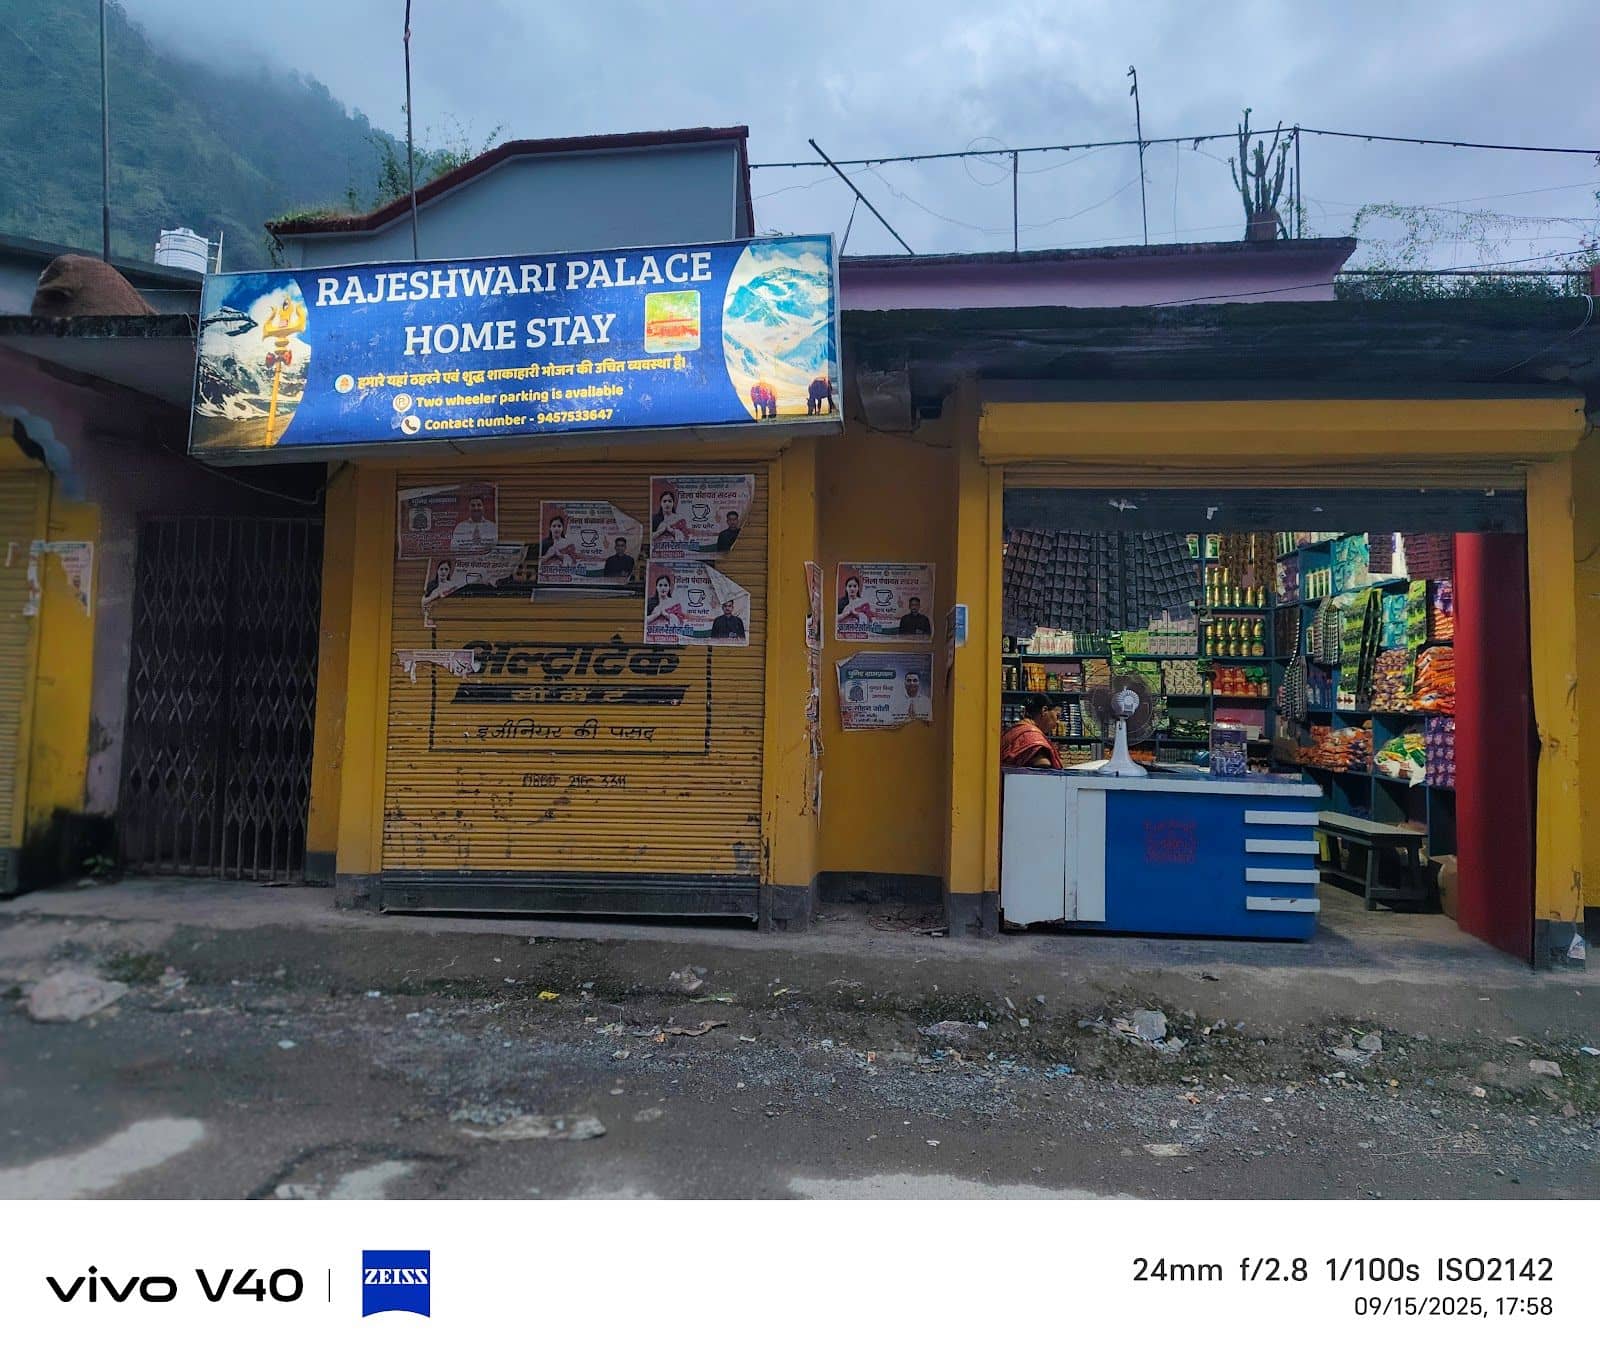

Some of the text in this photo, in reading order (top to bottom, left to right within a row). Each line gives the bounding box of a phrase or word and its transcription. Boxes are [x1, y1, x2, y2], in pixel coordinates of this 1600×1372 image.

[316, 252, 712, 307] RAJESHWARI PALACE
[403, 313, 616, 356] HOME STAY
[358, 373, 385, 389] हमारे
[410, 369, 441, 386] ठहरने
[443, 368, 460, 384] एवं
[462, 368, 486, 387] शुद्ध
[487, 363, 540, 381] शाकाहारी
[541, 362, 574, 377] भोजन
[576, 359, 593, 375] की
[595, 358, 625, 374] उचित
[627, 357, 672, 371] व्यवस्था
[416, 383, 624, 408] Two wheeler parking is available
[424, 417, 474, 430] Contact
[477, 414, 527, 429] number
[537, 409, 614, 425] 9457533647
[574, 718, 600, 739] की
